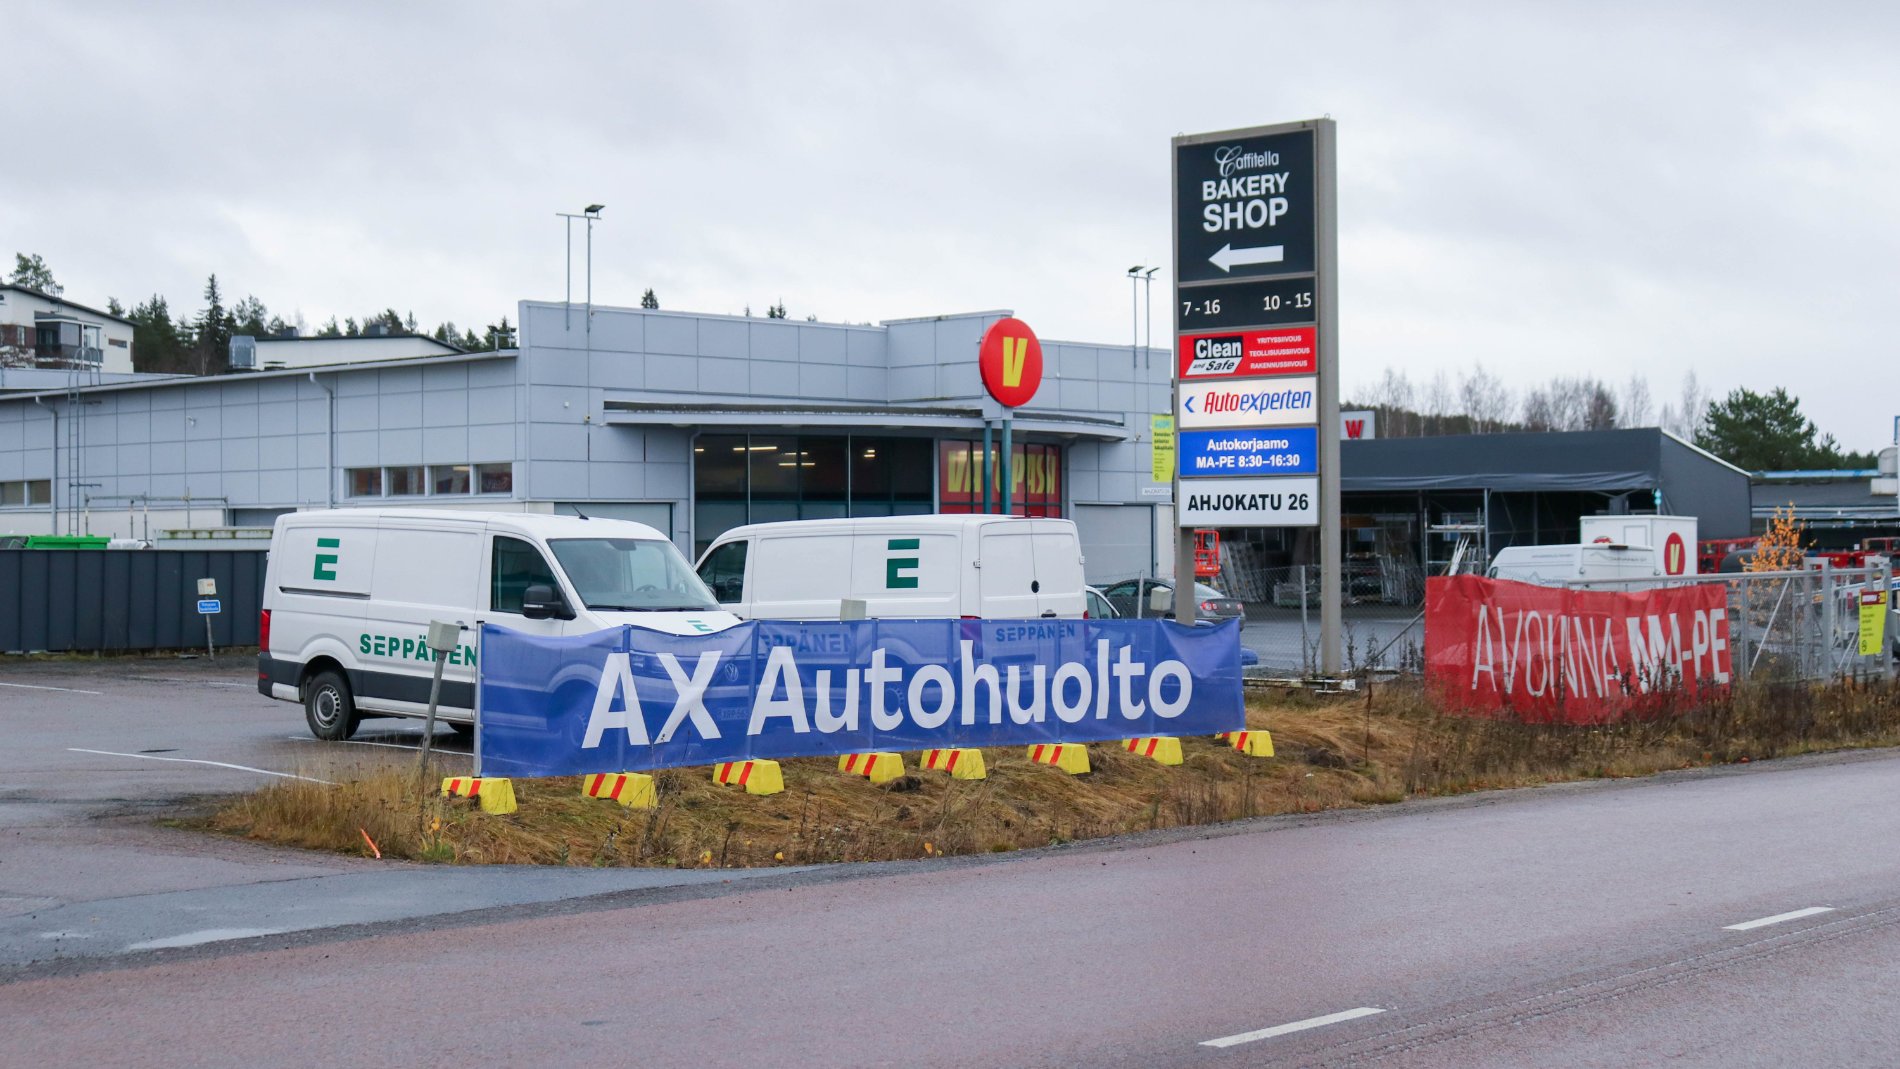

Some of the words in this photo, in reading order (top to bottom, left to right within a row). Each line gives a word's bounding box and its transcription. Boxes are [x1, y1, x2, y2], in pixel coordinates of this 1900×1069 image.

[1214, 146, 1280, 177] Caffitella
[1202, 172, 1290, 201] BAKERY
[1203, 197, 1289, 232] SHOP
[1183, 301, 1192, 316] 7
[1204, 299, 1221, 315] 16
[1263, 295, 1281, 310] 10
[1295, 292, 1312, 308] 15
[1195, 338, 1242, 358] Clean
[1003, 336, 1028, 387] V
[1206, 359, 1235, 371] Safe
[1204, 389, 1312, 415] Autoexperten
[1345, 419, 1363, 438] W
[1207, 438, 1289, 452] Autokorjaamo
[947, 450, 1057, 494] VAPASSI
[1196, 456, 1235, 469] MA-PE
[1187, 494, 1282, 511] AHJOKATU
[1288, 493, 1309, 511] 26
[995, 622, 1075, 642] SEPPÄNEN
[581, 649, 723, 749] AX
[746, 638, 1193, 736] Autohuolto
